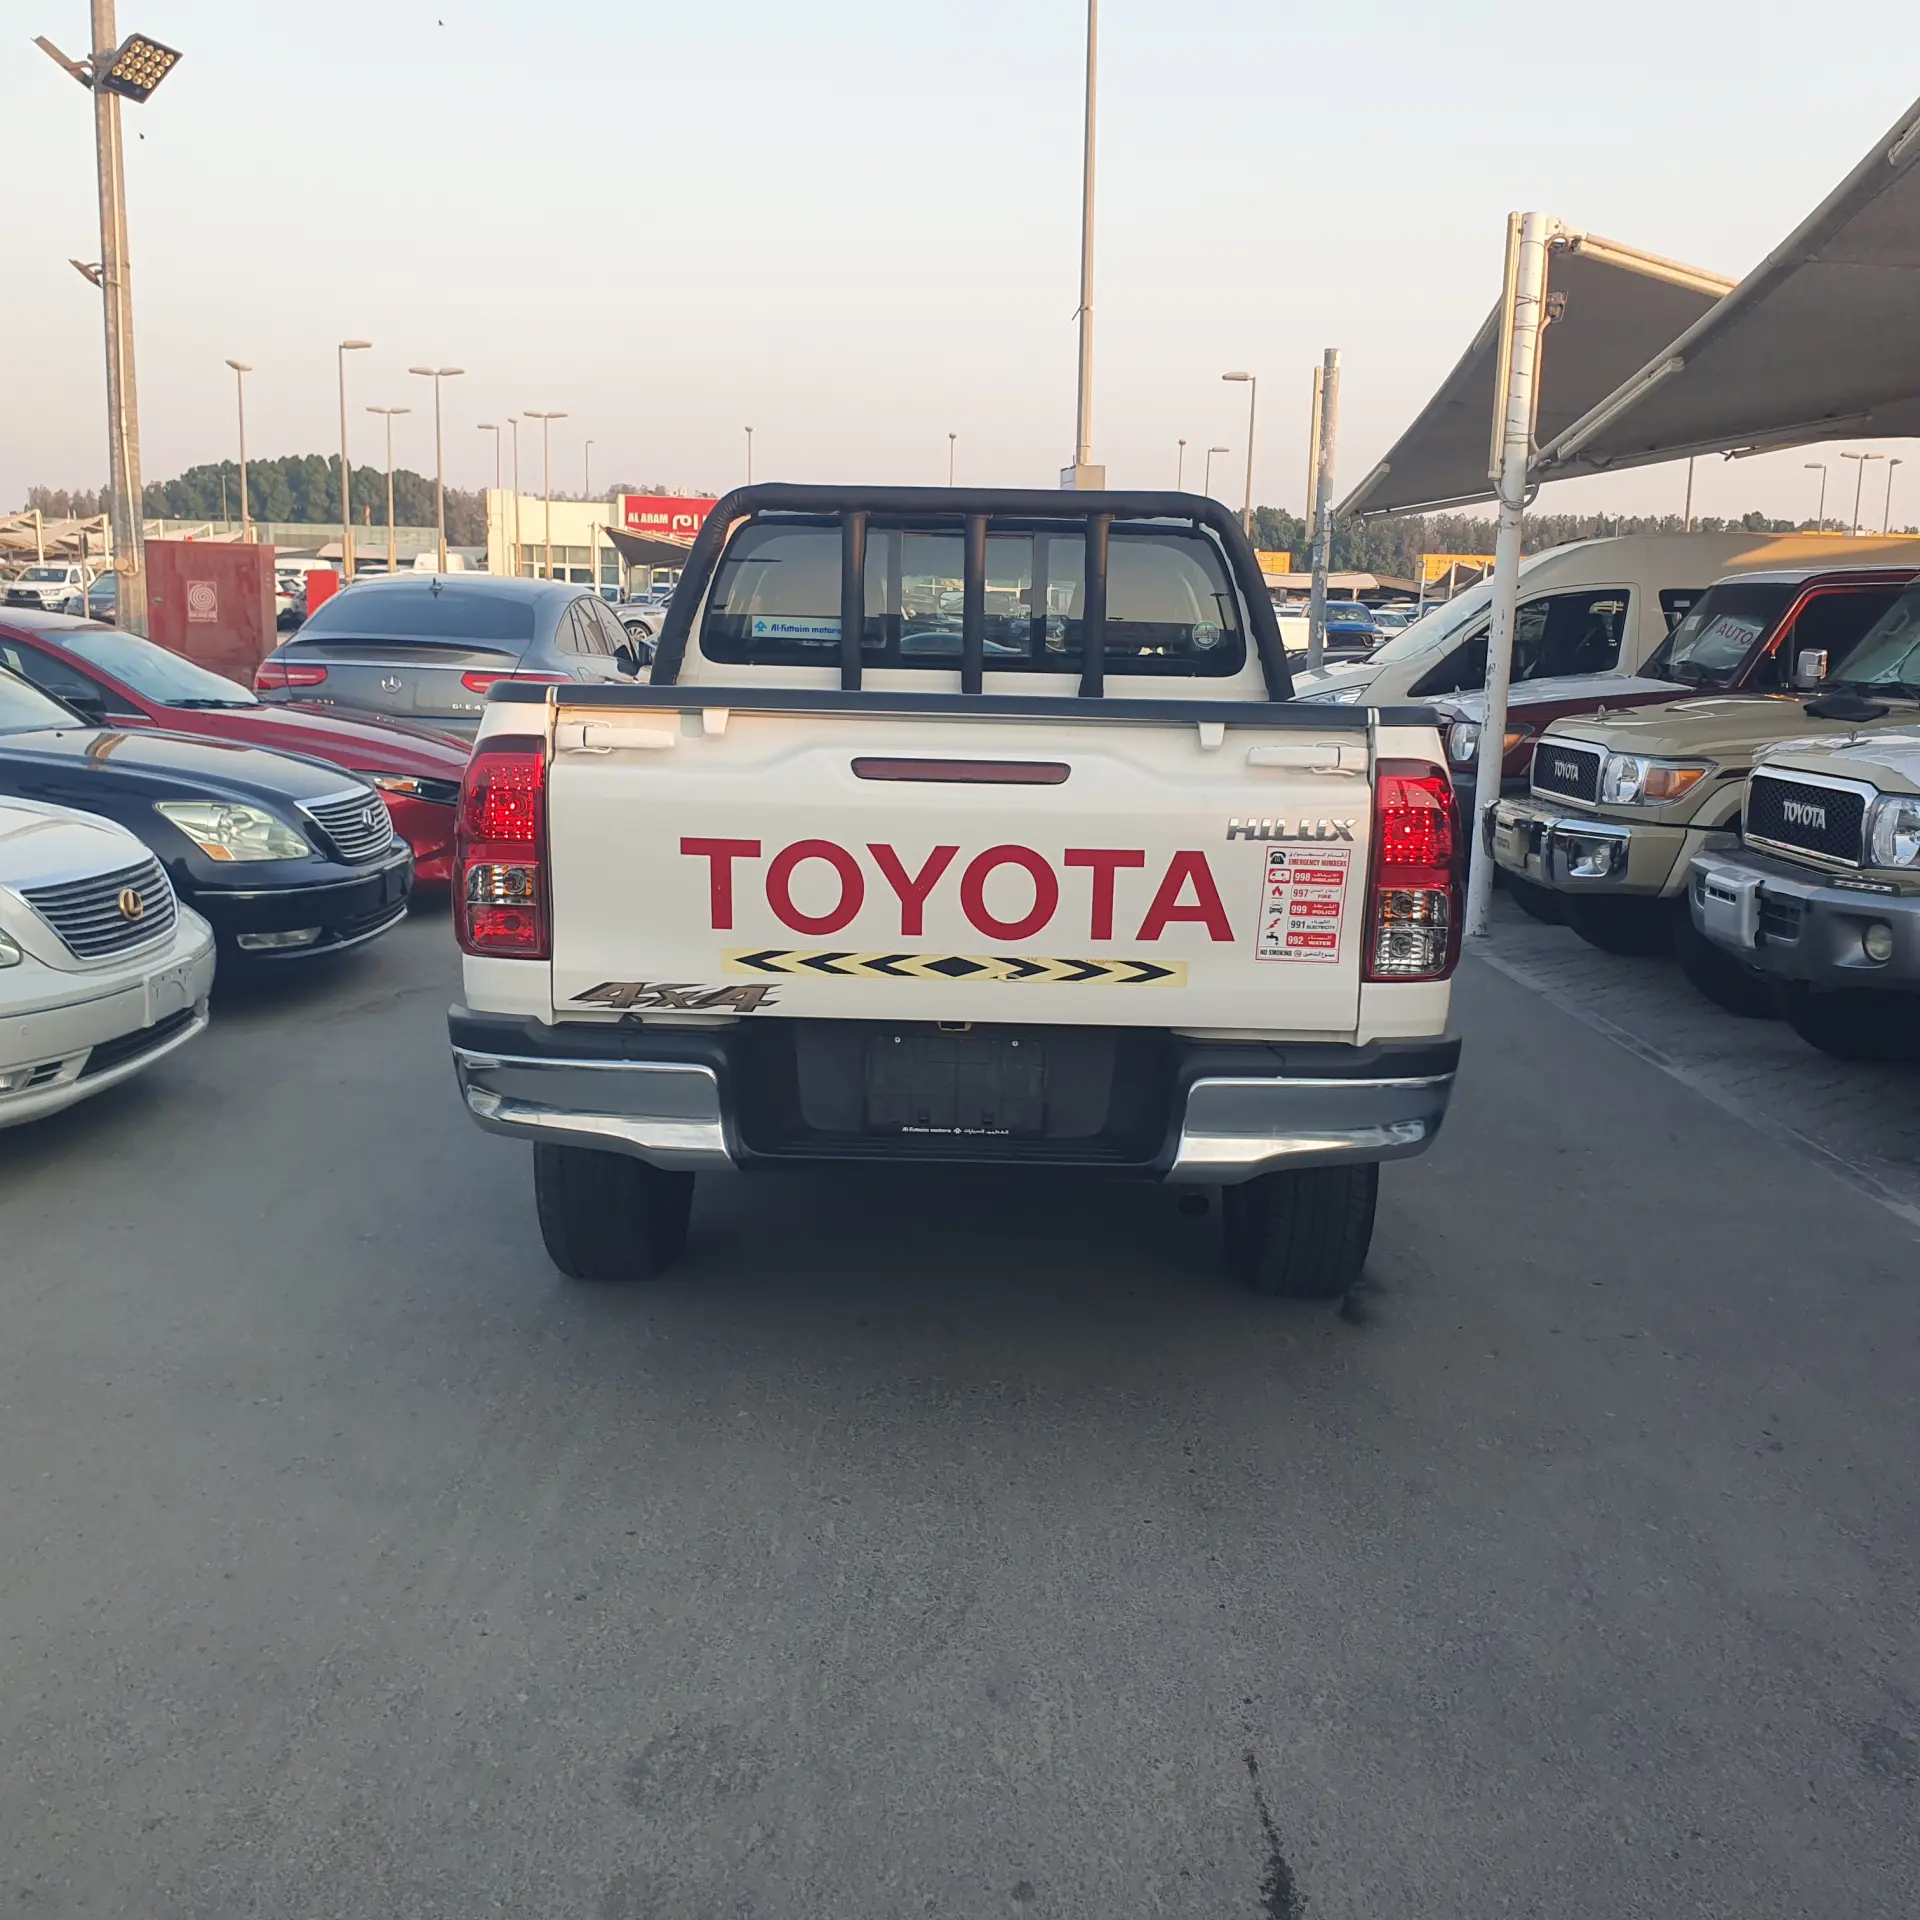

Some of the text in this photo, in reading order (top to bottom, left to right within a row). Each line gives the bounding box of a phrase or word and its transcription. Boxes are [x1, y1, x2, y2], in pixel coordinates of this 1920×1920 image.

[628, 512, 668, 524] AL ARAM
[770, 623, 810, 633] Al-Futtaim
[1554, 760, 1579, 781] TOYOTA
[1783, 800, 1826, 830] TOYOTA
[1226, 818, 1357, 841] HILUX
[1294, 872, 1311, 882] 998
[680, 837, 1235, 941] TOYOTA
[1293, 888, 1309, 898] 997
[1291, 904, 1307, 914] 999
[1290, 920, 1306, 930] 991
[1287, 935, 1304, 945] 992
[1268, 949, 1293, 957] SMOKING
